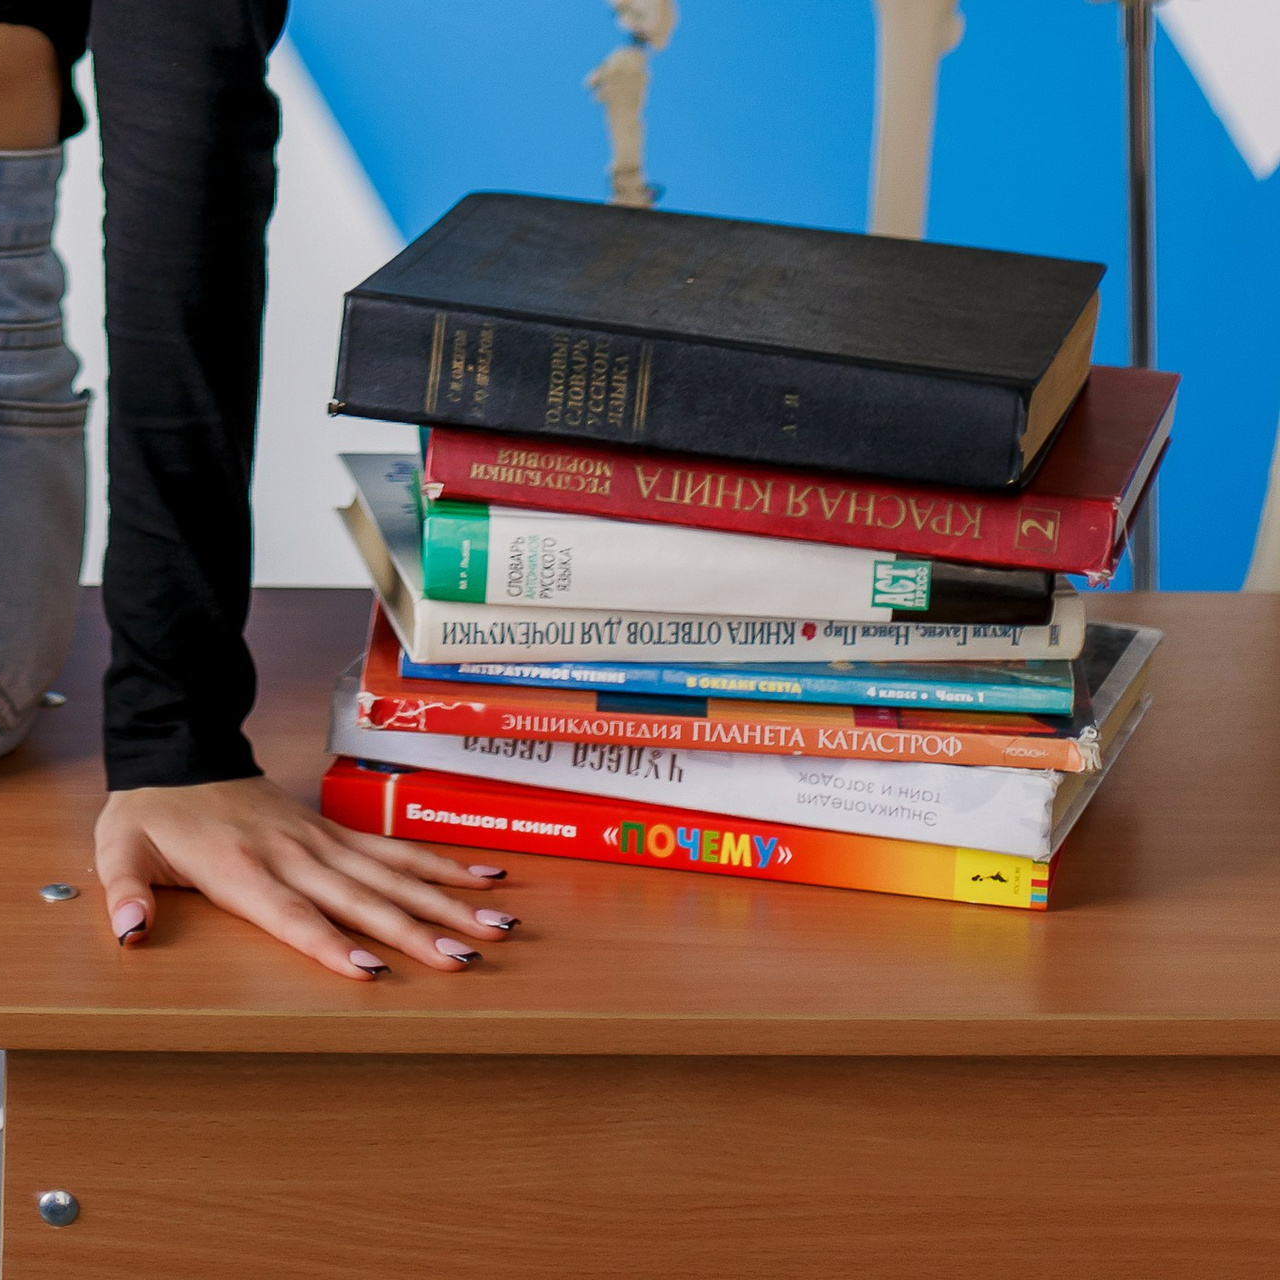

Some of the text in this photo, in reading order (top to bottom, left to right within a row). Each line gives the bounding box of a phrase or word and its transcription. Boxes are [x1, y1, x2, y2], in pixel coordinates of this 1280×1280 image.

[565, 337, 590, 426] СЛОВАРЬ
[607, 354, 630, 426] ЯЗЫКА
[469, 462, 612, 496] РЕСПУБЛИКИ
[496, 449, 613, 477] МОРДОВИЯ
[633, 463, 984, 540] КРАСНАЯ КНИГА
[1020, 518, 1055, 541] 2
[506, 536, 526, 598] СЛОВАРЬ
[539, 536, 558, 599] РУССКОГО
[874, 563, 918, 607] АСТ
[581, 616, 623, 646] ДЛЯ
[626, 621, 723, 646] ОТВЕТОВ
[726, 621, 797, 646] КНИГА
[823, 620, 858, 646] Пир
[861, 624, 910, 646] Нэнси
[758, 680, 803, 695] СВЕТА
[866, 686, 877, 698] 4
[879, 689, 918, 701] класс
[936, 689, 974, 703] Часть
[501, 713, 963, 758] ЭНЦИКЛОПЕДИЯ ПЛАНЕТА КАТАСТРОФ
[798, 771, 942, 804] тайн и загадок
[797, 792, 938, 827] Энциклопедия
[406, 803, 793, 869] Большая книга «ПОЧЕМУ»
